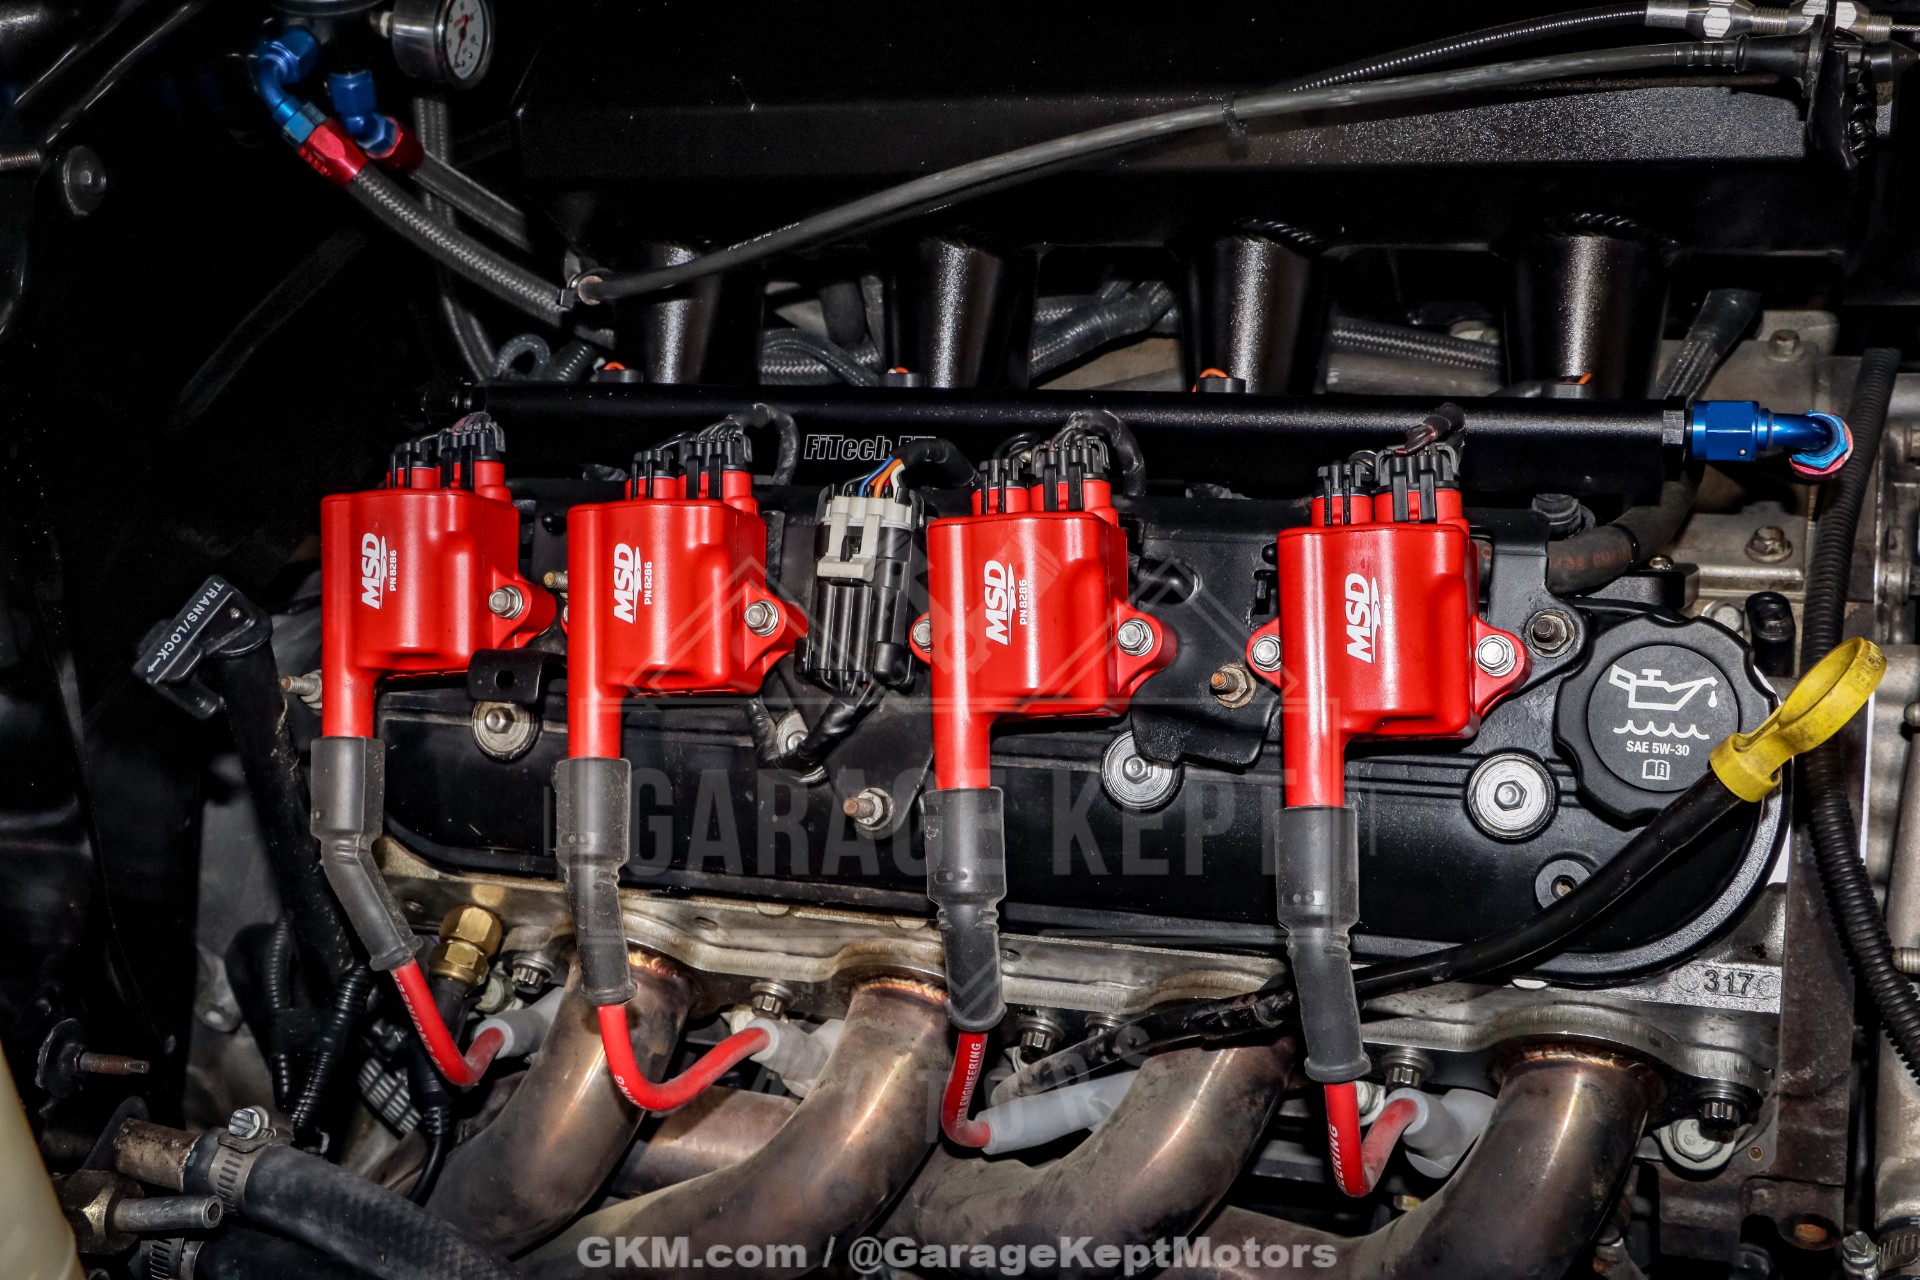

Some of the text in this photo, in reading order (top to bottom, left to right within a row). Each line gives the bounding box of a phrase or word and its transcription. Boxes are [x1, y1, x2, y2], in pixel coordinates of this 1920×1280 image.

[803, 434, 893, 460] FiTech
[361, 532, 381, 610] MSD
[389, 550, 397, 592] PN 8286
[613, 542, 634, 624] MSD
[643, 561, 653, 605] PN 8286
[157, 581, 225, 661] TRANS/LOCK
[983, 559, 1009, 646] MSD
[1019, 579, 1028, 625] PN 8286
[1344, 572, 1372, 664] MSD
[1626, 740, 1690, 756] SAE 5W-30
[1703, 969, 1755, 995] 317
[959, 1043, 982, 1107] ENGINEERING
